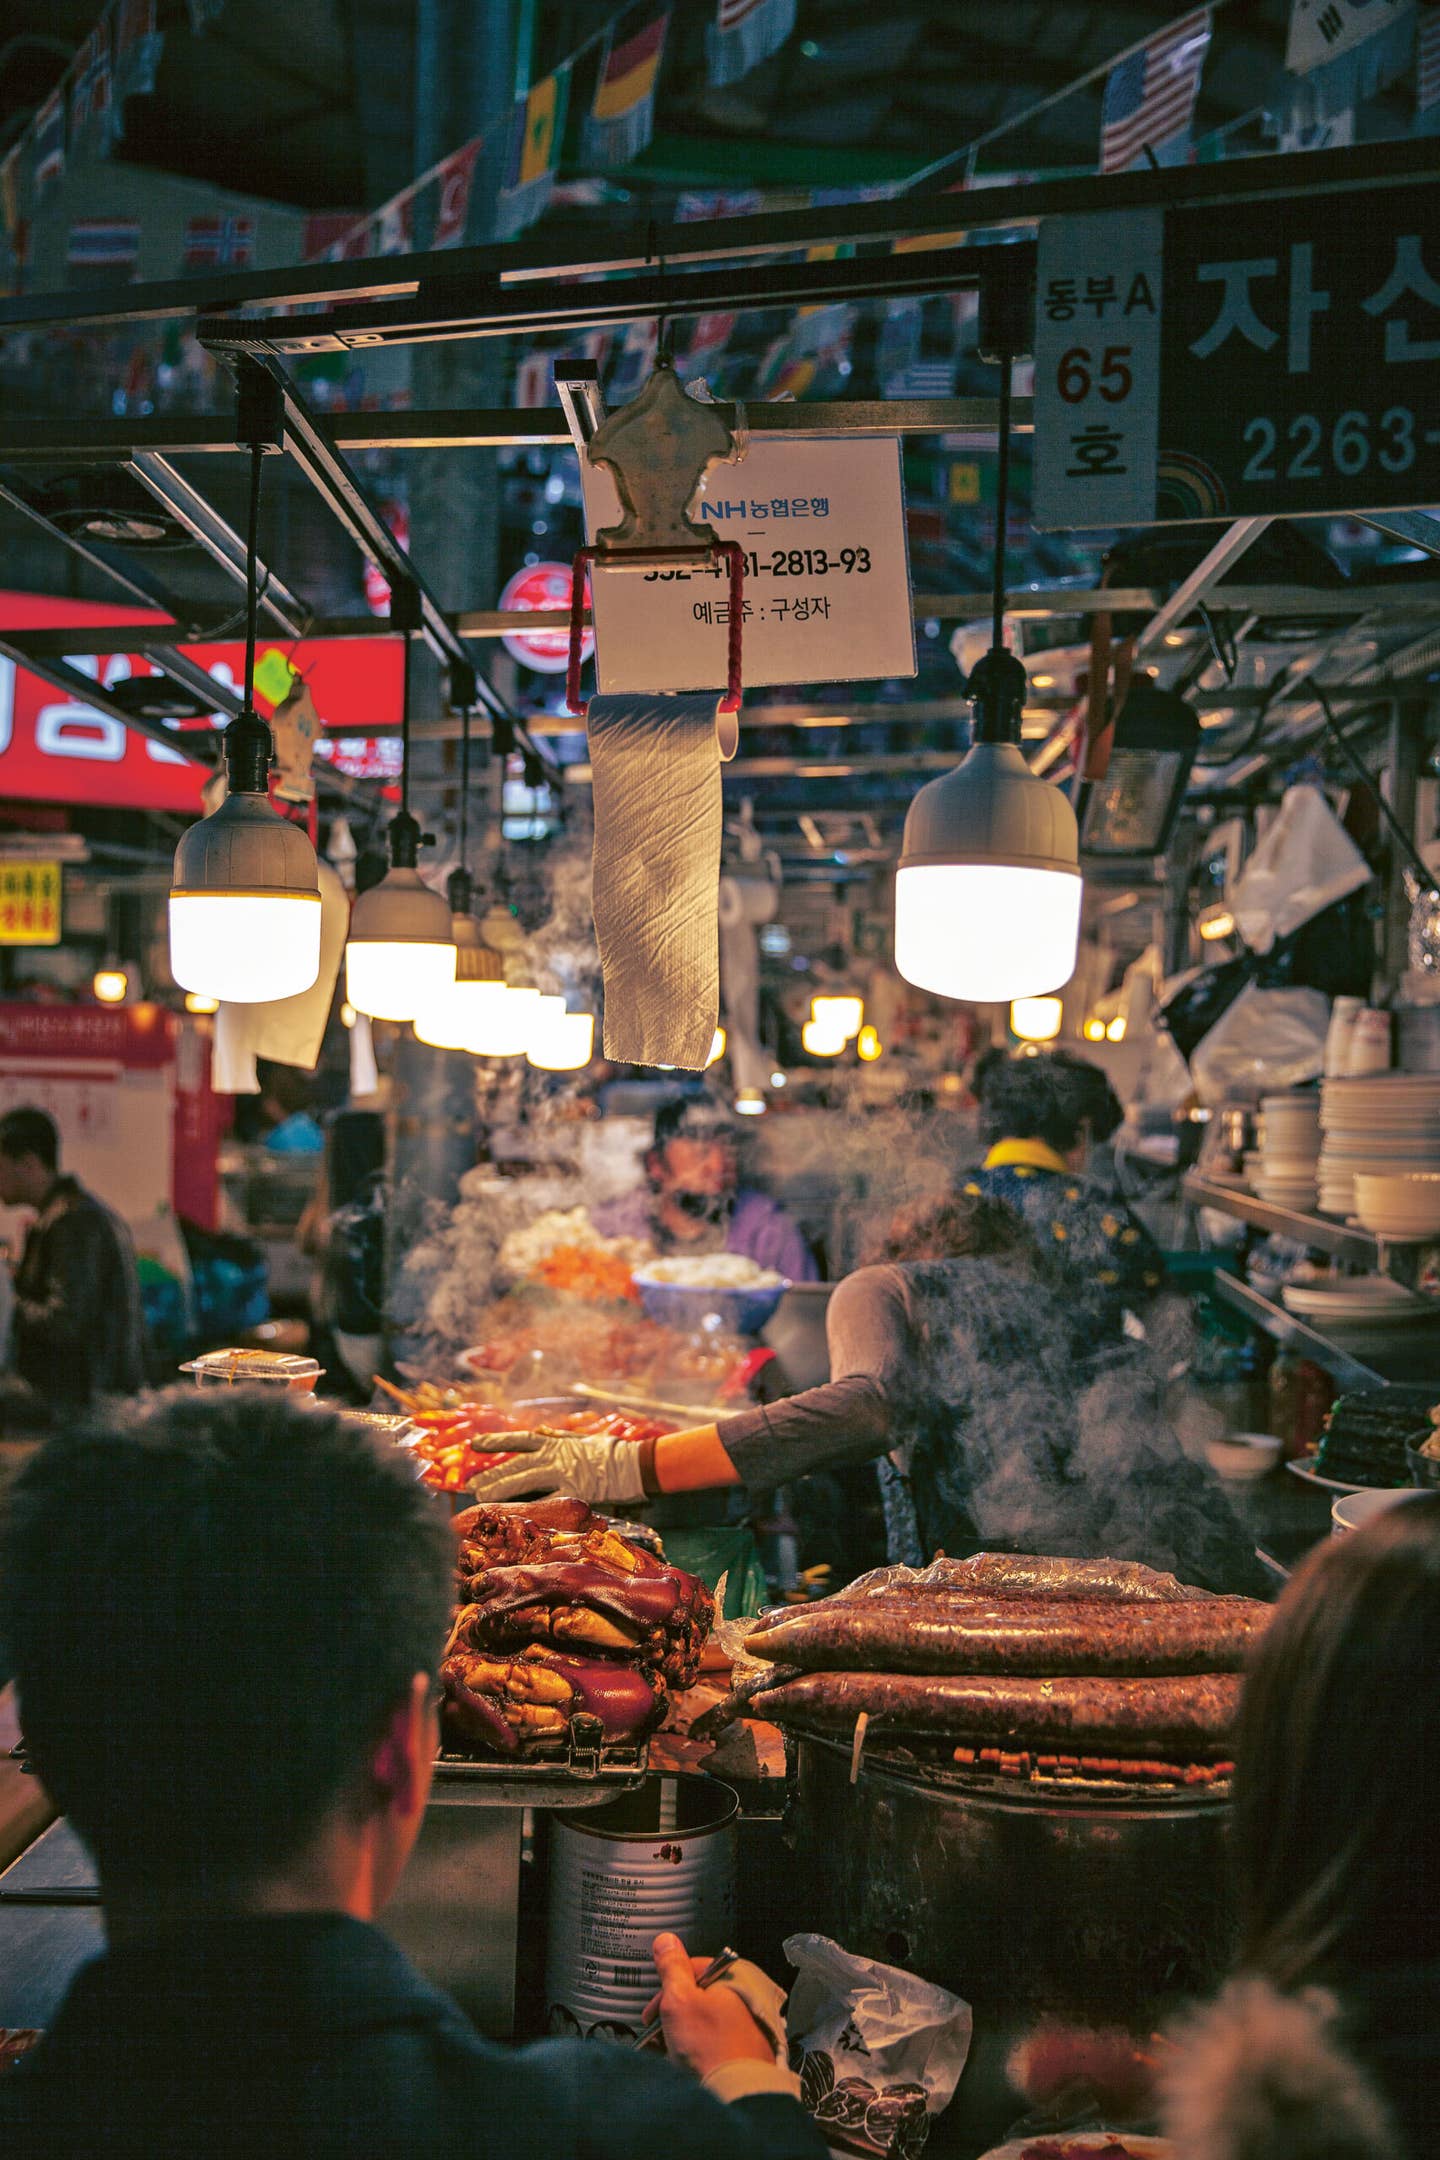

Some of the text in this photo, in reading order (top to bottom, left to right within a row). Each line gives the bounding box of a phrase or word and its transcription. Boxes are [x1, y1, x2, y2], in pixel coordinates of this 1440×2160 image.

[1044, 272, 1157, 322] 동부A
[1057, 346, 1133, 404] 65
[1065, 425, 1127, 478] 호
[770, 595, 831, 622] 구성자
